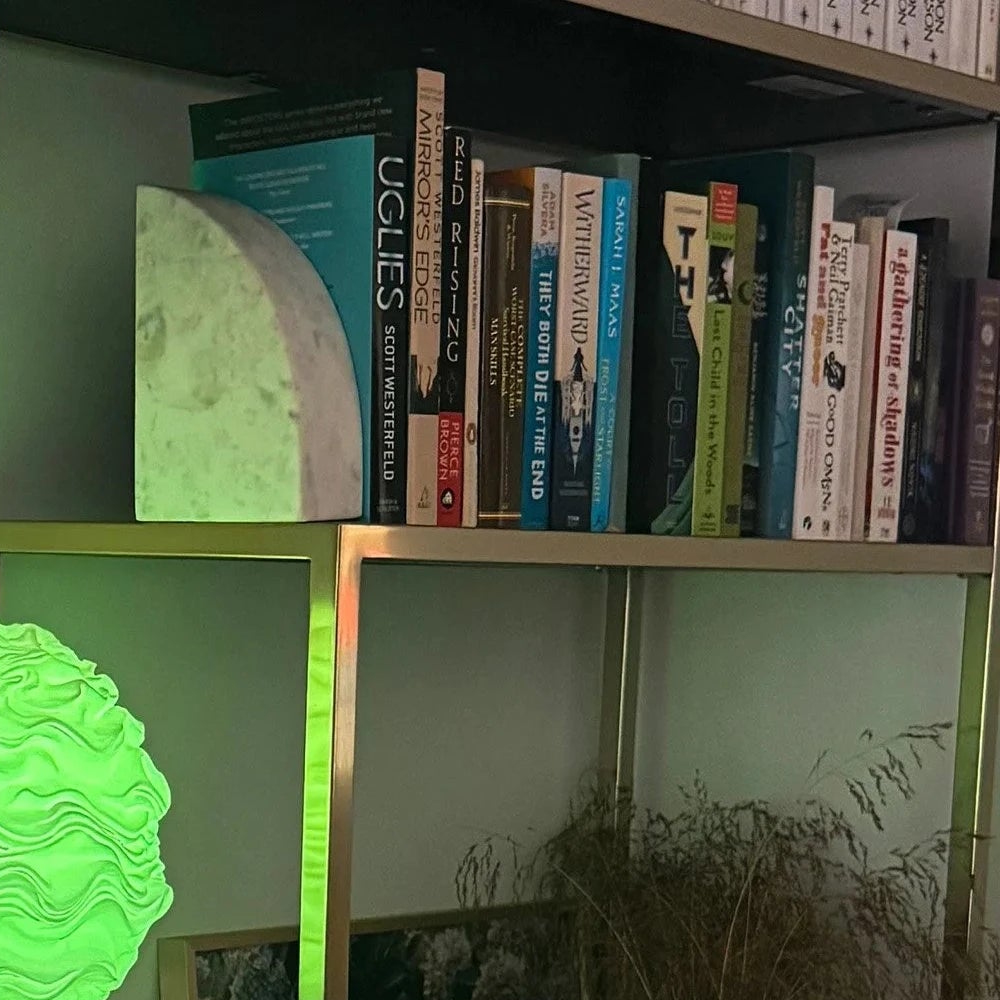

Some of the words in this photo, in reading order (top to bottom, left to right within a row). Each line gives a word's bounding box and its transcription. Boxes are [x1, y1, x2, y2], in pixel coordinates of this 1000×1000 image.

[415, 108, 433, 242] MIRROR'S
[450, 135, 467, 206] RED
[376, 155, 406, 311] UGLIES
[473, 208, 482, 253] Baldwin
[540, 182, 551, 238] SILVERA
[548, 190, 558, 231] ADAM
[613, 195, 627, 258] SARAH
[431, 192, 443, 325] WESTERFELD
[828, 251, 841, 283] Neil
[839, 236, 853, 276] Terry
[897, 247, 909, 259] a
[413, 249, 430, 325] EDGE
[445, 221, 464, 363] RISING
[538, 271, 553, 318] THEY
[672, 225, 698, 339] THE
[607, 282, 621, 339] MAAS
[713, 310, 726, 342] Last
[826, 288, 839, 344] Gaiman
[836, 281, 851, 344] Pratchett
[887, 262, 911, 371] gathering
[383, 324, 397, 379] SCOTT
[537, 320, 552, 365] BOTH
[710, 346, 723, 390] Child
[781, 305, 795, 377] CITY
[790, 271, 807, 411] SHATTER
[534, 369, 550, 404] DIE
[709, 393, 718, 409] in
[888, 372, 900, 389] of
[382, 376, 397, 481] WESTERFELD
[534, 427, 546, 455] THE
[535, 405, 545, 427] AT
[666, 356, 691, 507] TOLL
[707, 413, 720, 440] the
[879, 396, 902, 488] shadows
[438, 419, 450, 481] BROWN
[448, 421, 460, 480] PIERCE
[704, 443, 718, 495] Woods
[530, 459, 546, 500] END
